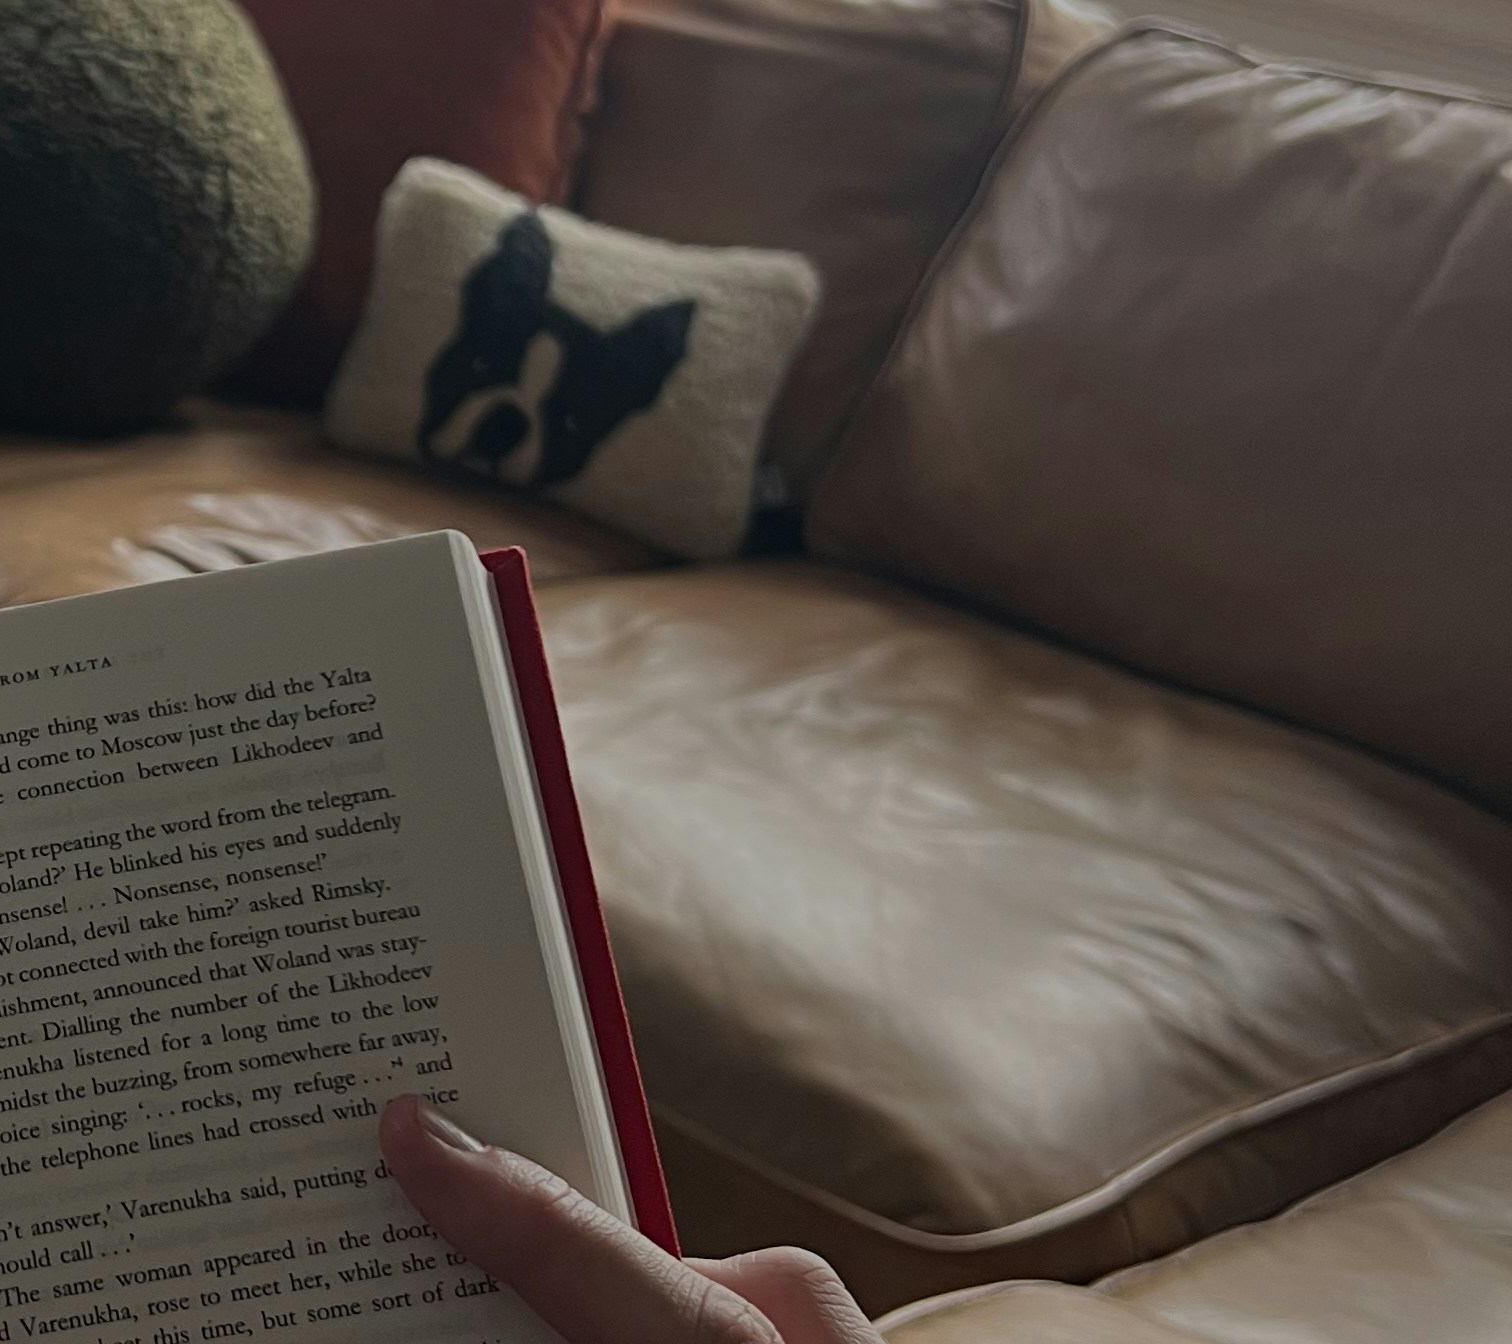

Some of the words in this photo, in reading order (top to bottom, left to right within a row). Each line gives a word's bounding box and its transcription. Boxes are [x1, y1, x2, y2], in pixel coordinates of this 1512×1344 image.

[46, 714, 99, 736] thing
[102, 708, 140, 726] was
[146, 697, 189, 719] this:
[193, 691, 237, 711] how
[243, 679, 277, 702] did
[282, 676, 314, 696] the
[318, 666, 372, 689] Yalta
[48, 655, 112, 677] YALTA
[15, 750, 71, 771] come
[74, 746, 96, 761] to
[99, 730, 183, 756] Moscow
[187, 722, 226, 747] just
[229, 714, 261, 734] the
[265, 708, 299, 730] day
[302, 692, 377, 722] before?
[16, 768, 125, 801] connection
[135, 754, 220, 780] between
[230, 734, 334, 764] Likhodeev
[346, 721, 384, 745] and
[17, 947, 121, 983] connected
[123, 940, 169, 964] with
[172, 936, 205, 957] the
[208, 924, 281, 951] foreign
[283, 912, 350, 938] tourist
[350, 904, 421, 927] bureau
[53, 1081, 87, 1103] the
[90, 1068, 178, 1096] buzzing,
[182, 1059, 233, 1081] from
[237, 1040, 353, 1072] somewhere
[357, 1031, 386, 1052] far
[390, 1026, 448, 1047] away,
[200, 1318, 254, 1341] time,
[259, 1309, 298, 1330] but
[305, 1301, 362, 1323] some
[370, 1291, 413, 1312] sort
[420, 1279, 444, 1304] of
[453, 1272, 501, 1298] dark
